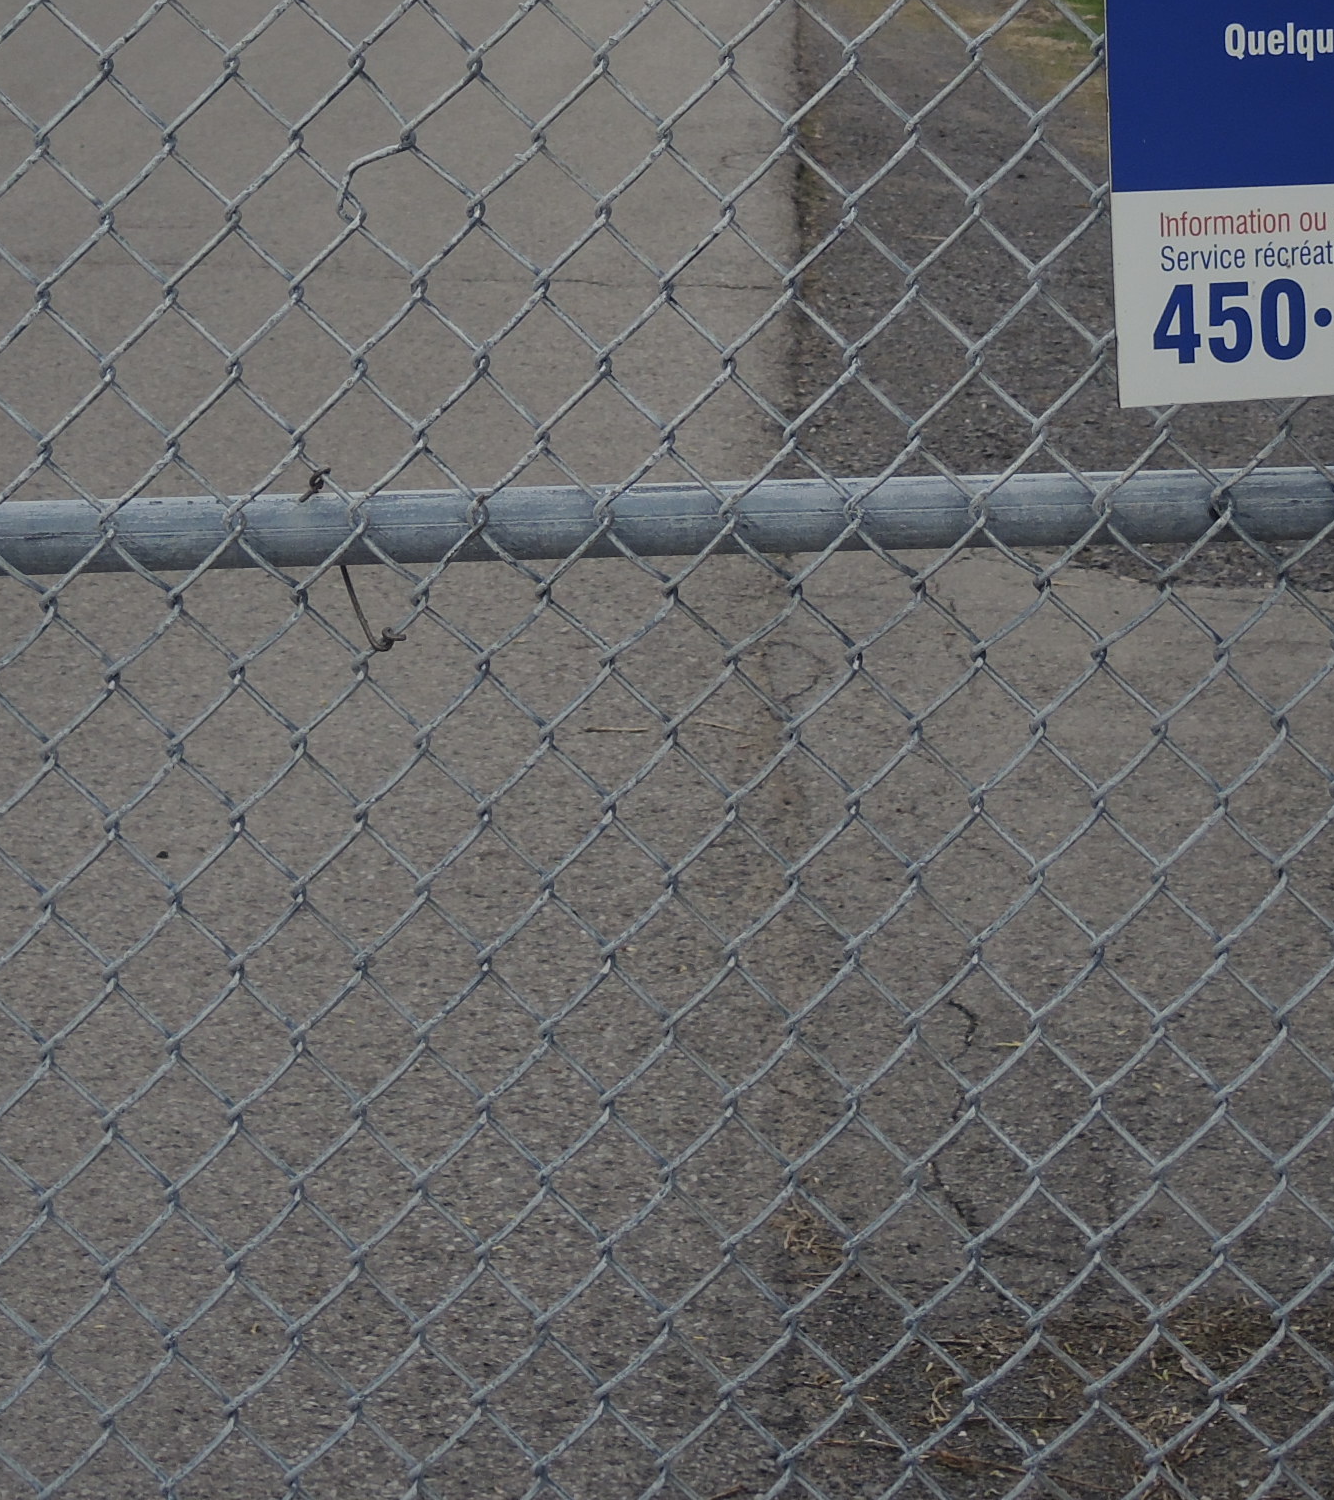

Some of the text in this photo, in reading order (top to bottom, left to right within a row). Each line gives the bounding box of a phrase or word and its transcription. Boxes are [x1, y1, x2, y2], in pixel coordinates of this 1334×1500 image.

[1159, 208, 1290, 238] Information
[1299, 211, 1327, 233] ou
[1160, 244, 1246, 273] Service
